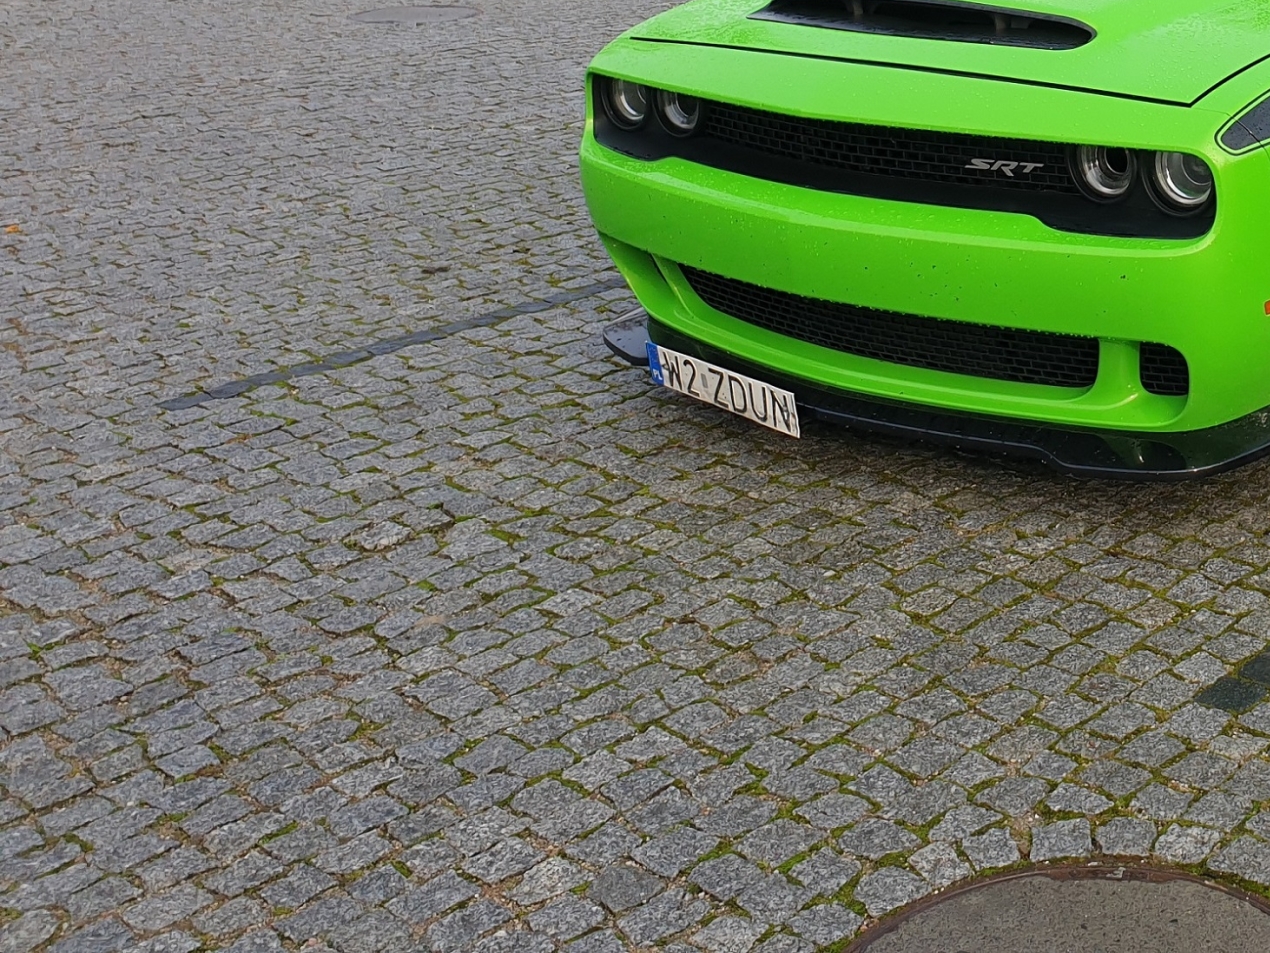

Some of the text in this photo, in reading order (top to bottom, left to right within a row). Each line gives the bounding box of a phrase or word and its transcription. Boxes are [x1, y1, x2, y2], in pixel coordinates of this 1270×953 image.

[964, 158, 1044, 177] SRT
[652, 368, 663, 381] PL
[662, 351, 795, 433] W2 ZDUN
